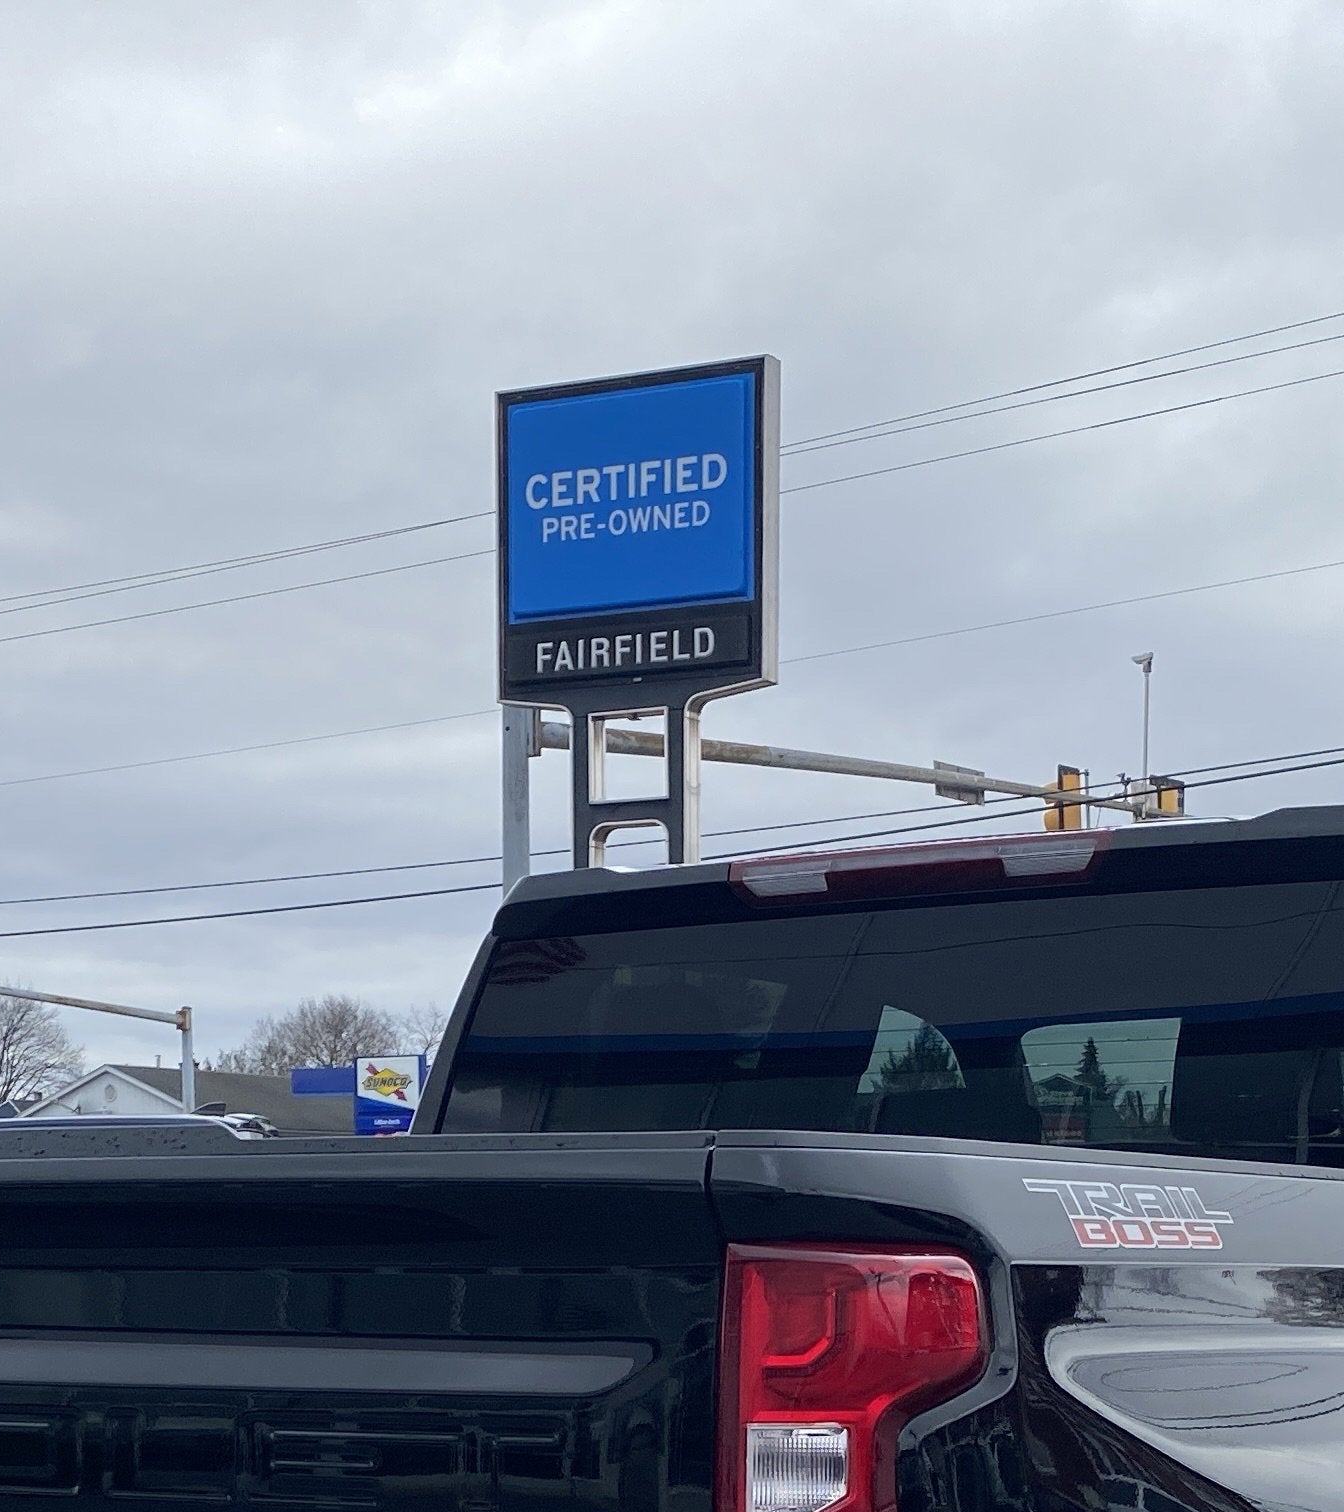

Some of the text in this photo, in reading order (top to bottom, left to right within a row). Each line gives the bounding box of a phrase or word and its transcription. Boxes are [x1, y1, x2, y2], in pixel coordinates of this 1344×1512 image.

[525, 453, 728, 510] CERTIFIED
[542, 500, 711, 543] PRE-OWNED
[536, 627, 716, 674] FAIRFIELD
[365, 1076, 408, 1089] SUNOCO
[1022, 1178, 1234, 1224] TRAIL
[1070, 1215, 1223, 1250] BOSS
